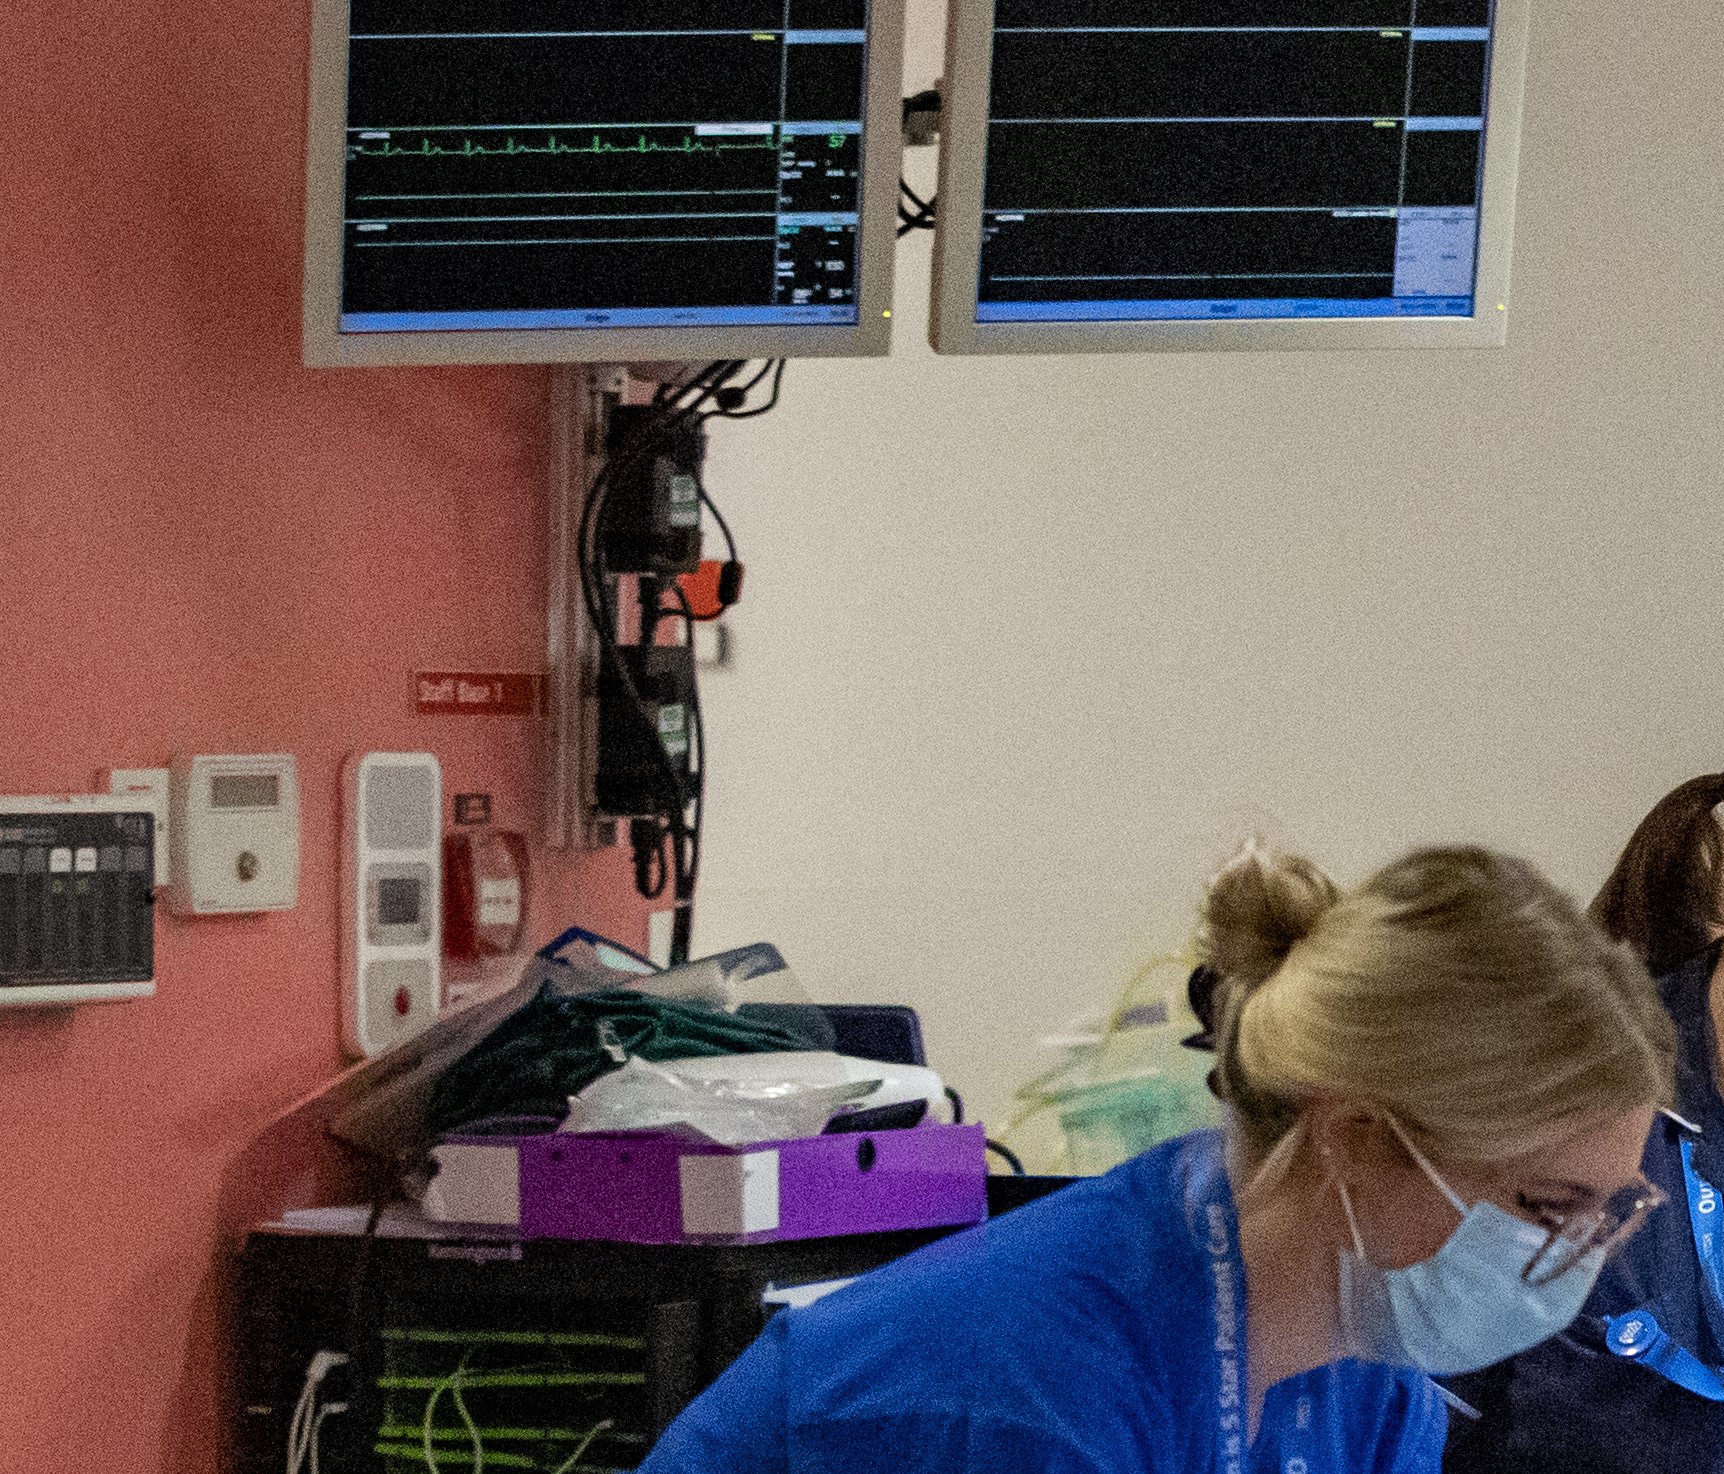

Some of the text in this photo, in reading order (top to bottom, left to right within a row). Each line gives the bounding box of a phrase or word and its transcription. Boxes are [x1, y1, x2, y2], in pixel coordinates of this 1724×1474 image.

[1206, 1204, 1229, 1255] Care
[1214, 1261, 1237, 1350] Patient
[1219, 1357, 1239, 1408] Star
